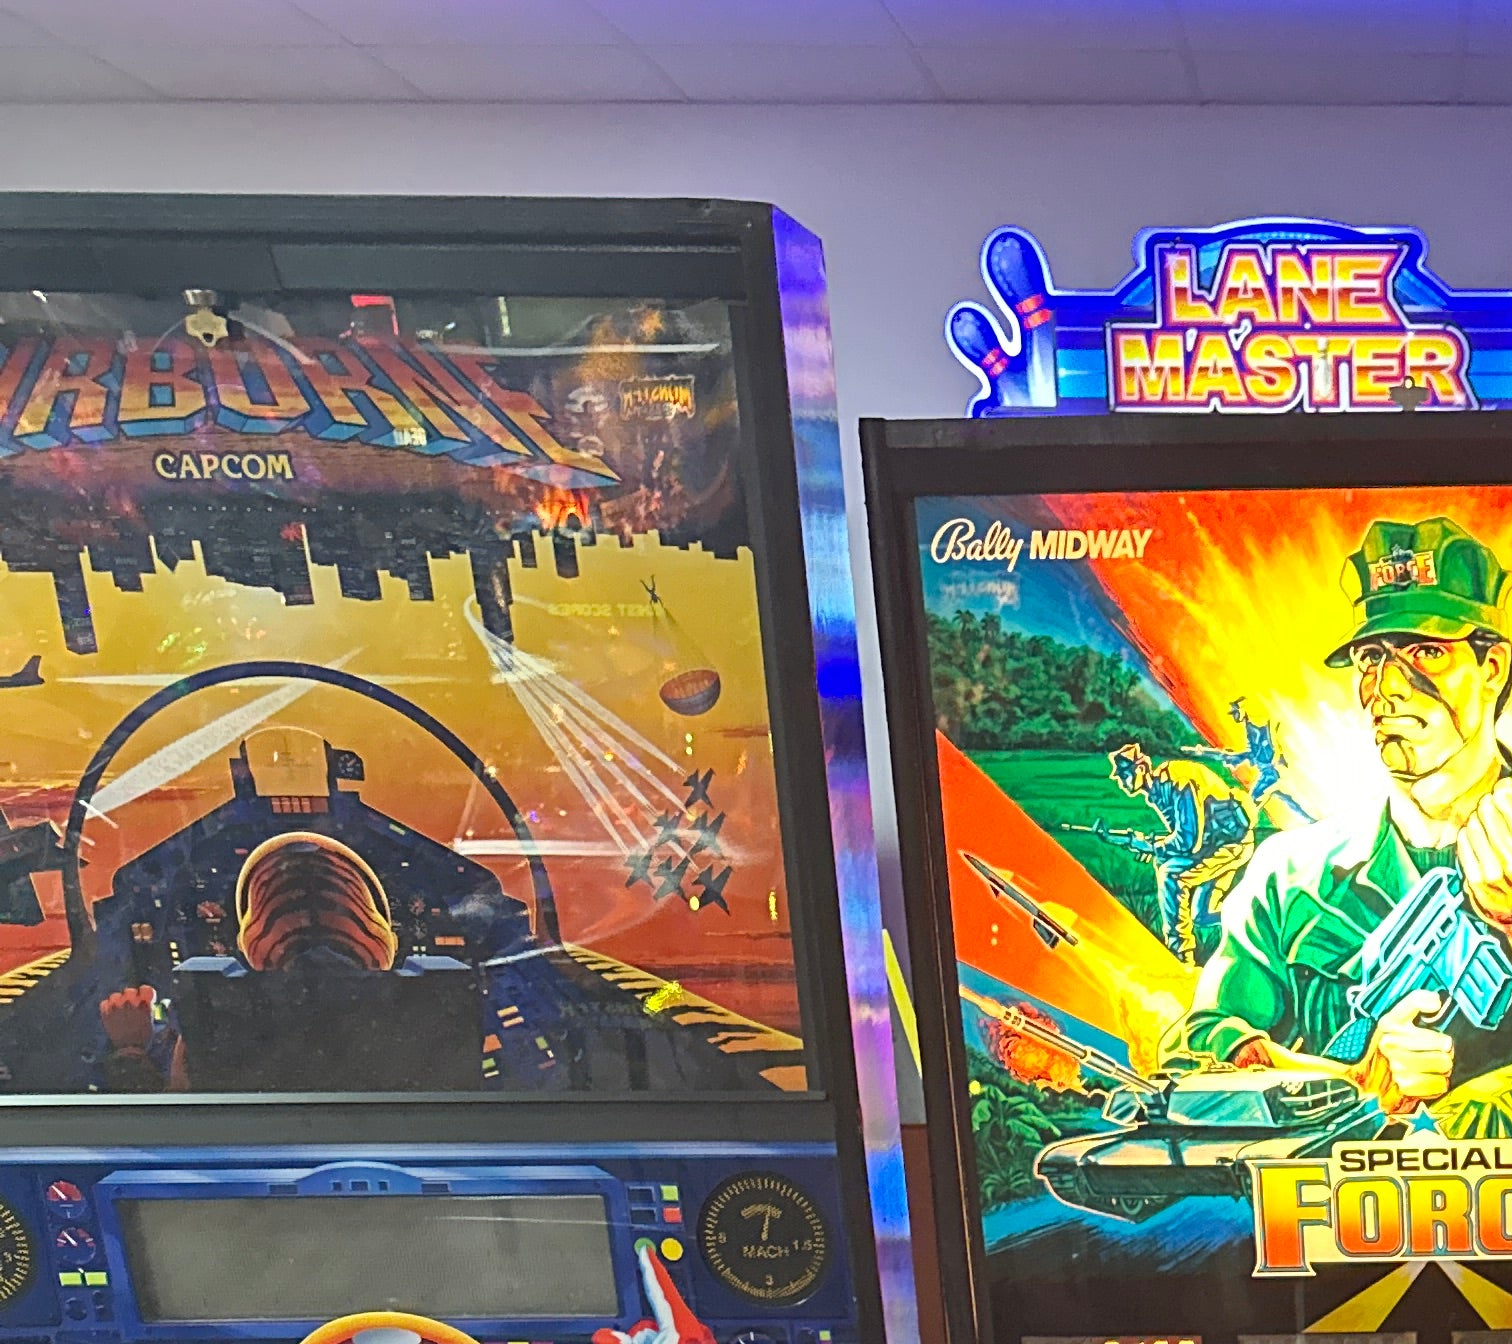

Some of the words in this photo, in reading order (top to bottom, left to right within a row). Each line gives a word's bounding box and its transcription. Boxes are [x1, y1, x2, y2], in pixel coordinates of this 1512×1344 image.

[1166, 247, 1400, 325] LANE
[1114, 330, 1465, 405] MASTER
[155, 453, 294, 480] CAPCOM
[931, 518, 1023, 572] Bally
[1029, 529, 1153, 560] MIDWAY
[743, 1244, 789, 1258] MACH
